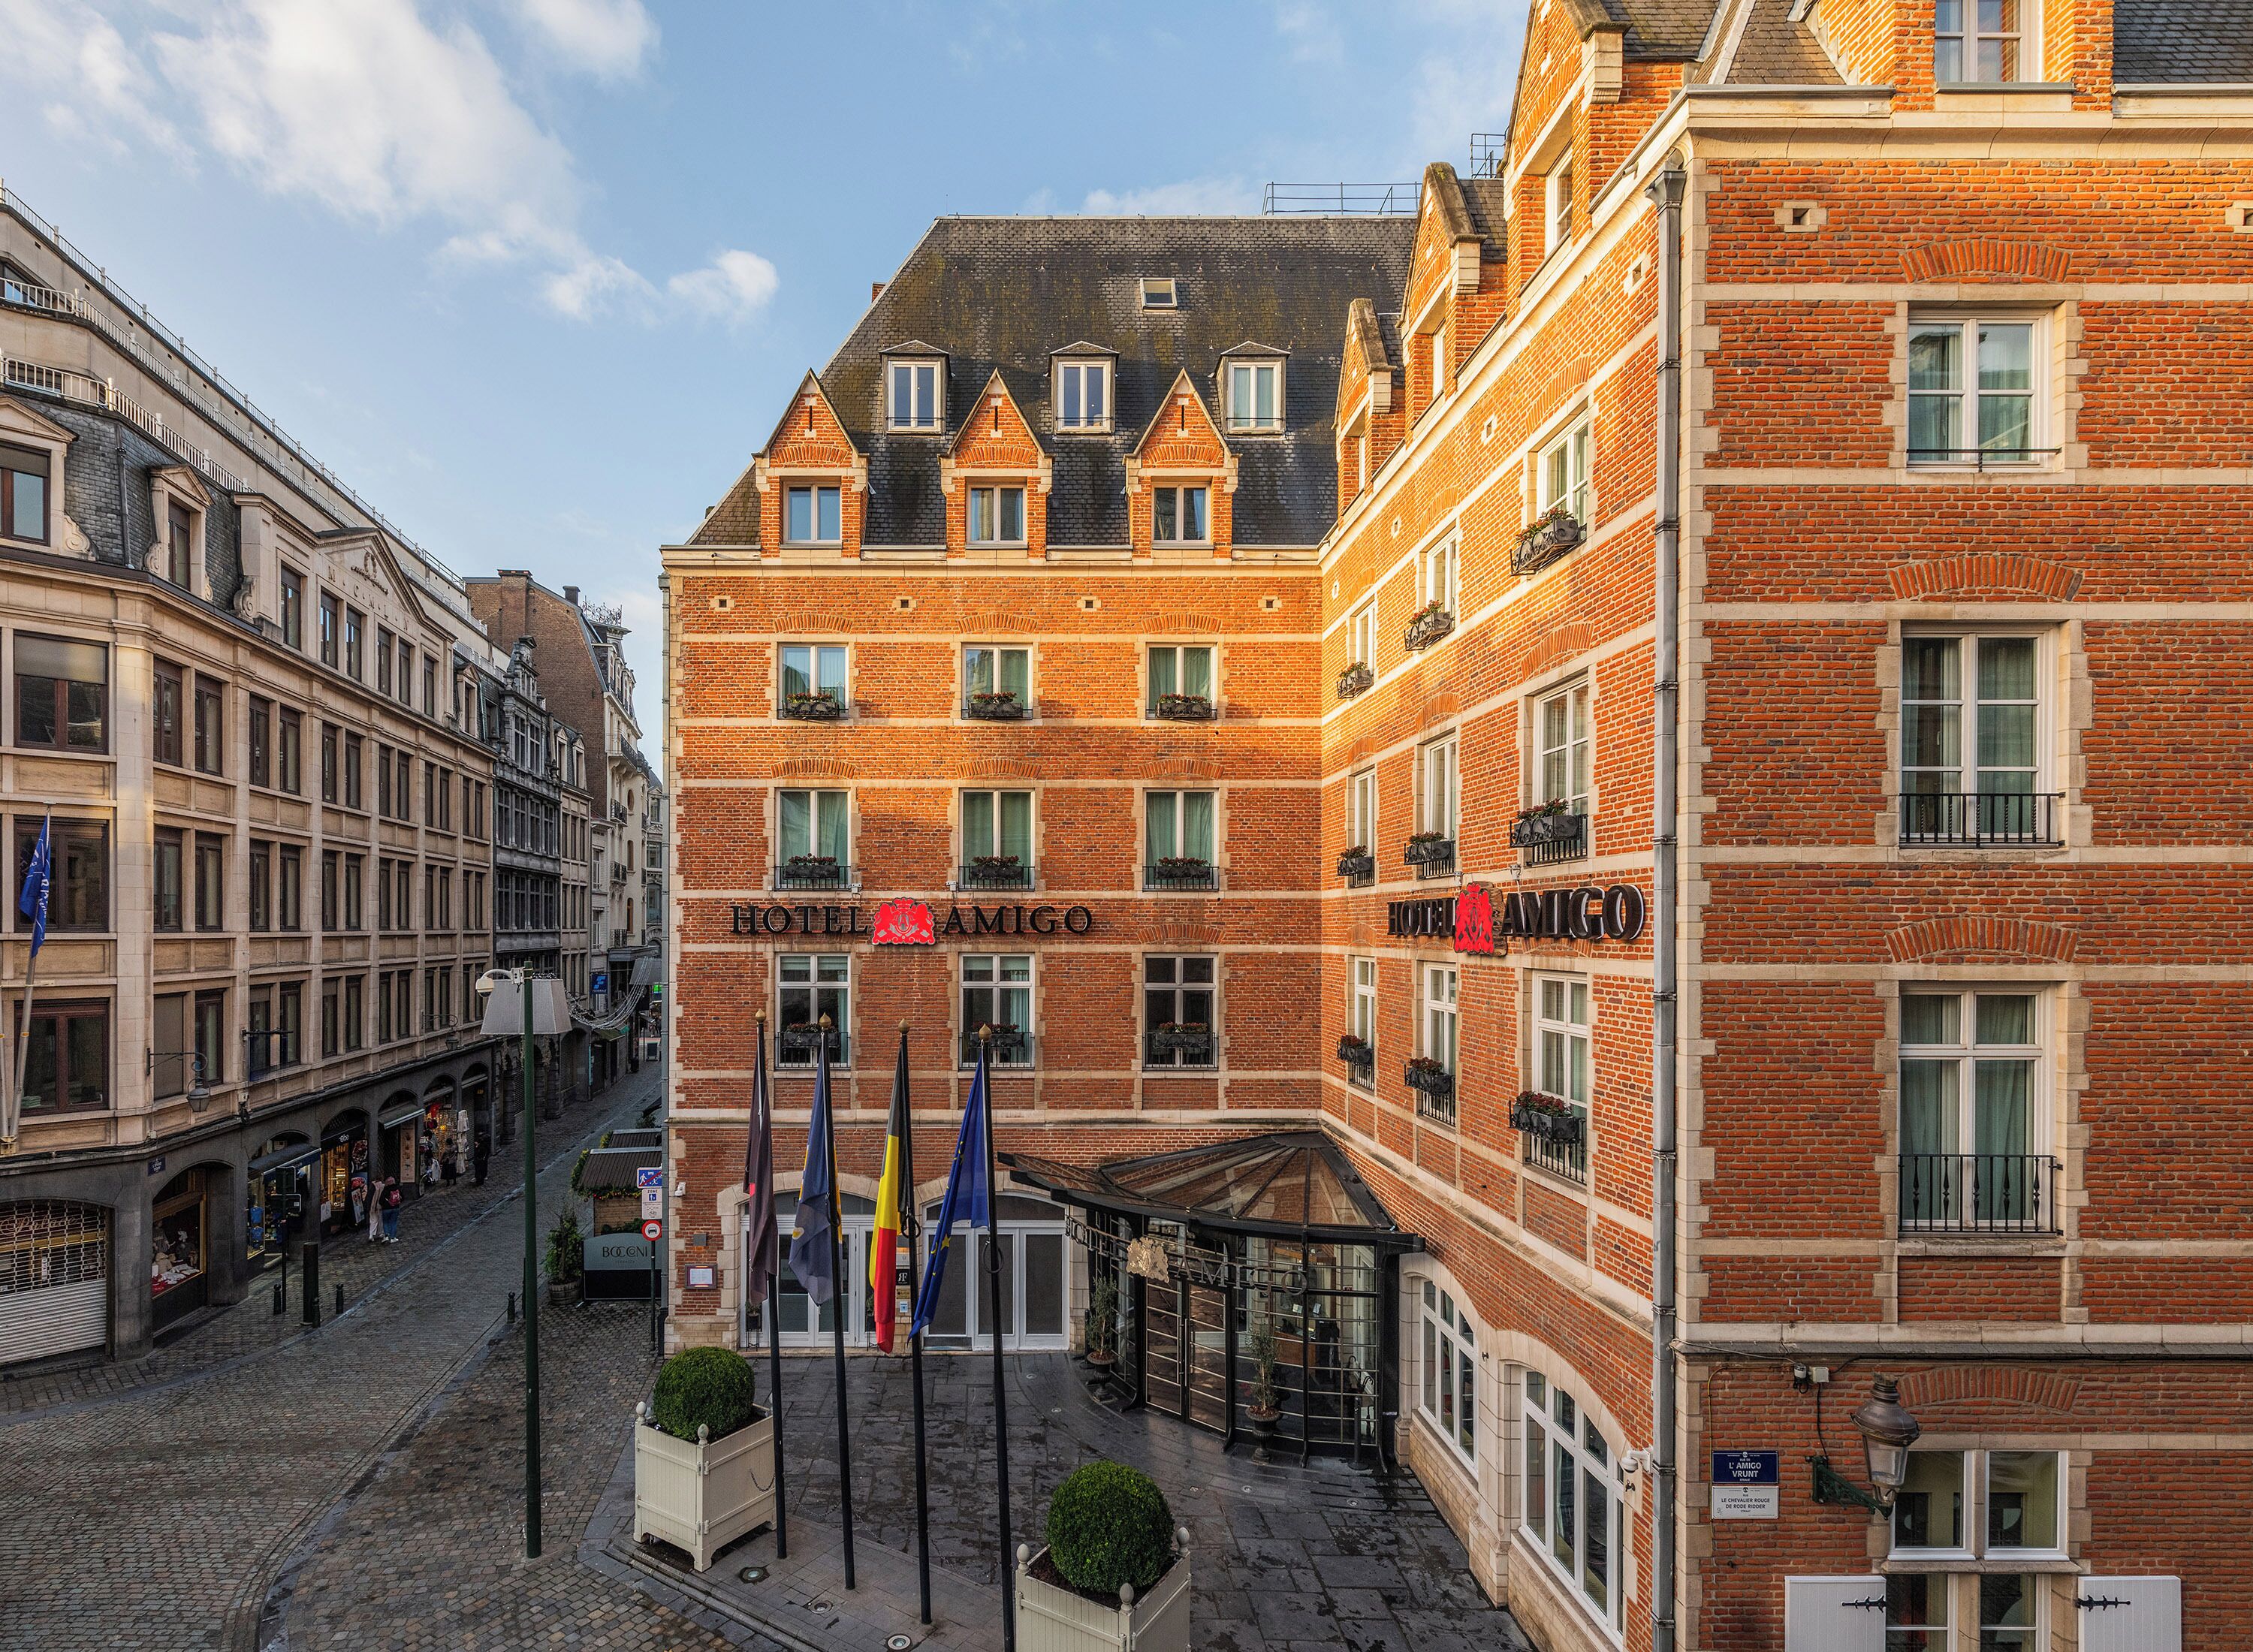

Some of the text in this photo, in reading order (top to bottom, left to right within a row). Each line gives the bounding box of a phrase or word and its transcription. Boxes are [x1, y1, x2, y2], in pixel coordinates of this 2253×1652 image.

[730, 904, 1093, 935] HOTEL AMIGO
[1387, 883, 1645, 941] HOTEL AMIGO
[602, 1246, 647, 1258] BOCCONI
[1065, 1214, 1308, 1296] HOTEL AMIGO
